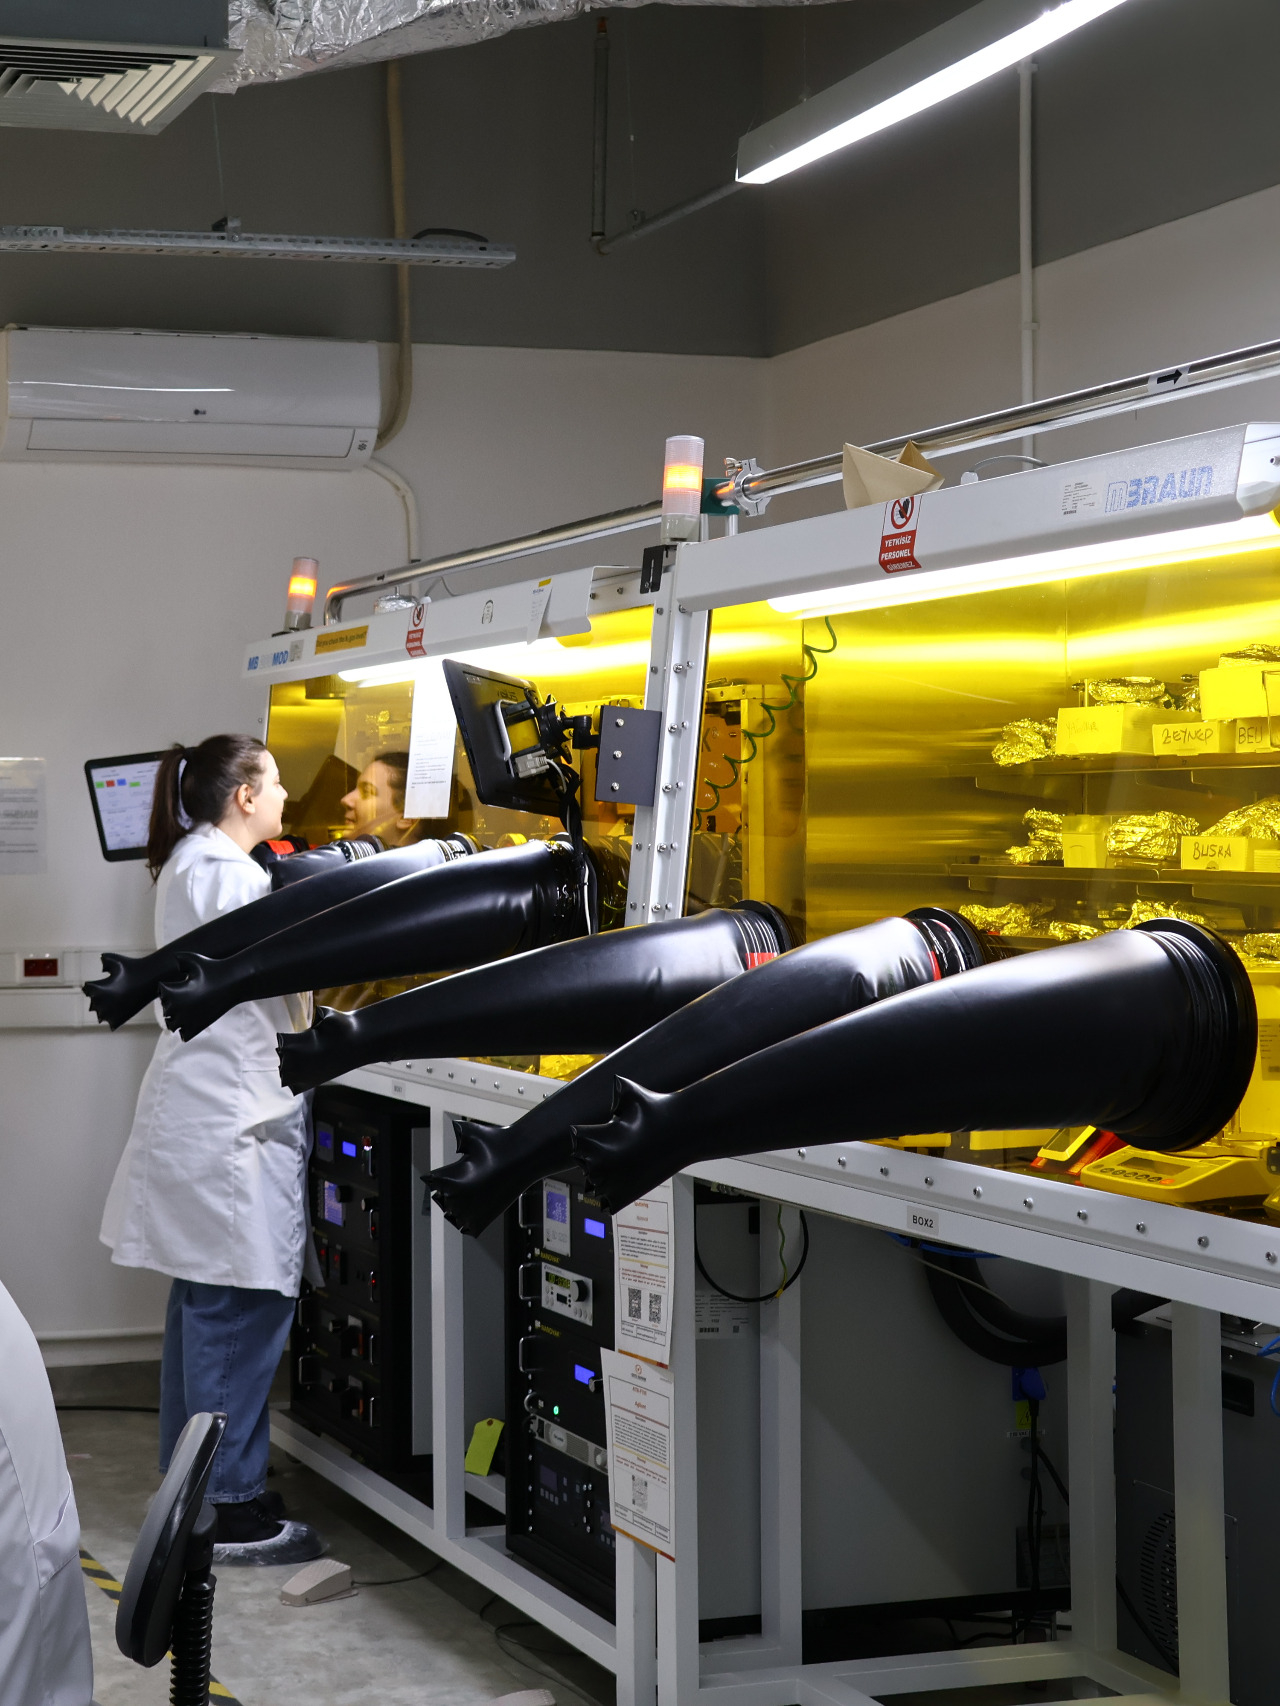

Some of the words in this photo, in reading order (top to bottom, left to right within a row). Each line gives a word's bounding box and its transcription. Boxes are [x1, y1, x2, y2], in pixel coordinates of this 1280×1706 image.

[885, 535, 912, 547] YETKİSİZ
[881, 548, 911, 561] PERSONEL
[912, 1215, 934, 1229] BOX2
